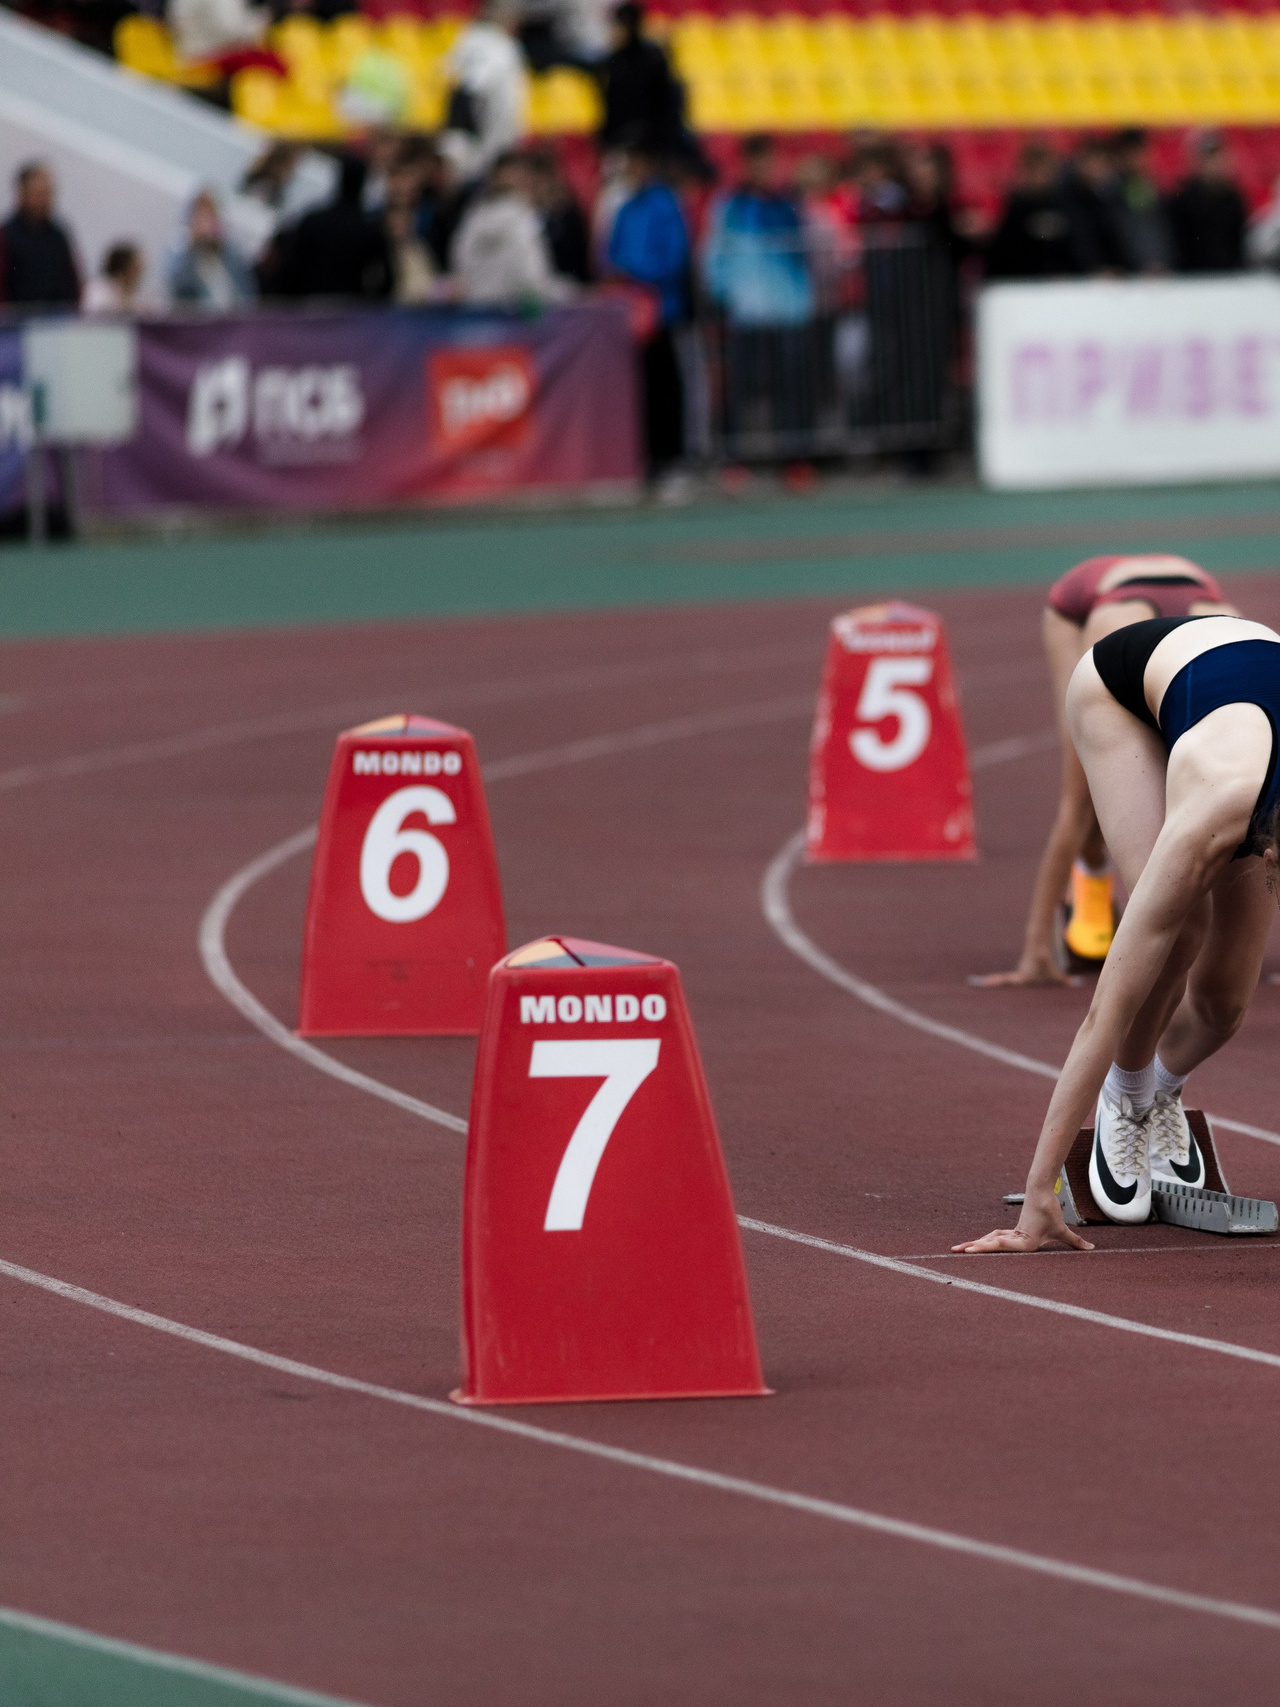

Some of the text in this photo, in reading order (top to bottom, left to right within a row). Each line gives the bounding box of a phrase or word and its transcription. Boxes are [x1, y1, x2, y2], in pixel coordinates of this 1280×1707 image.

[353, 751, 462, 776] MONDO
[849, 656, 934, 772] 5
[359, 784, 457, 923] 6
[520, 994, 667, 1024] MONDO
[528, 1038, 661, 1232] 7
